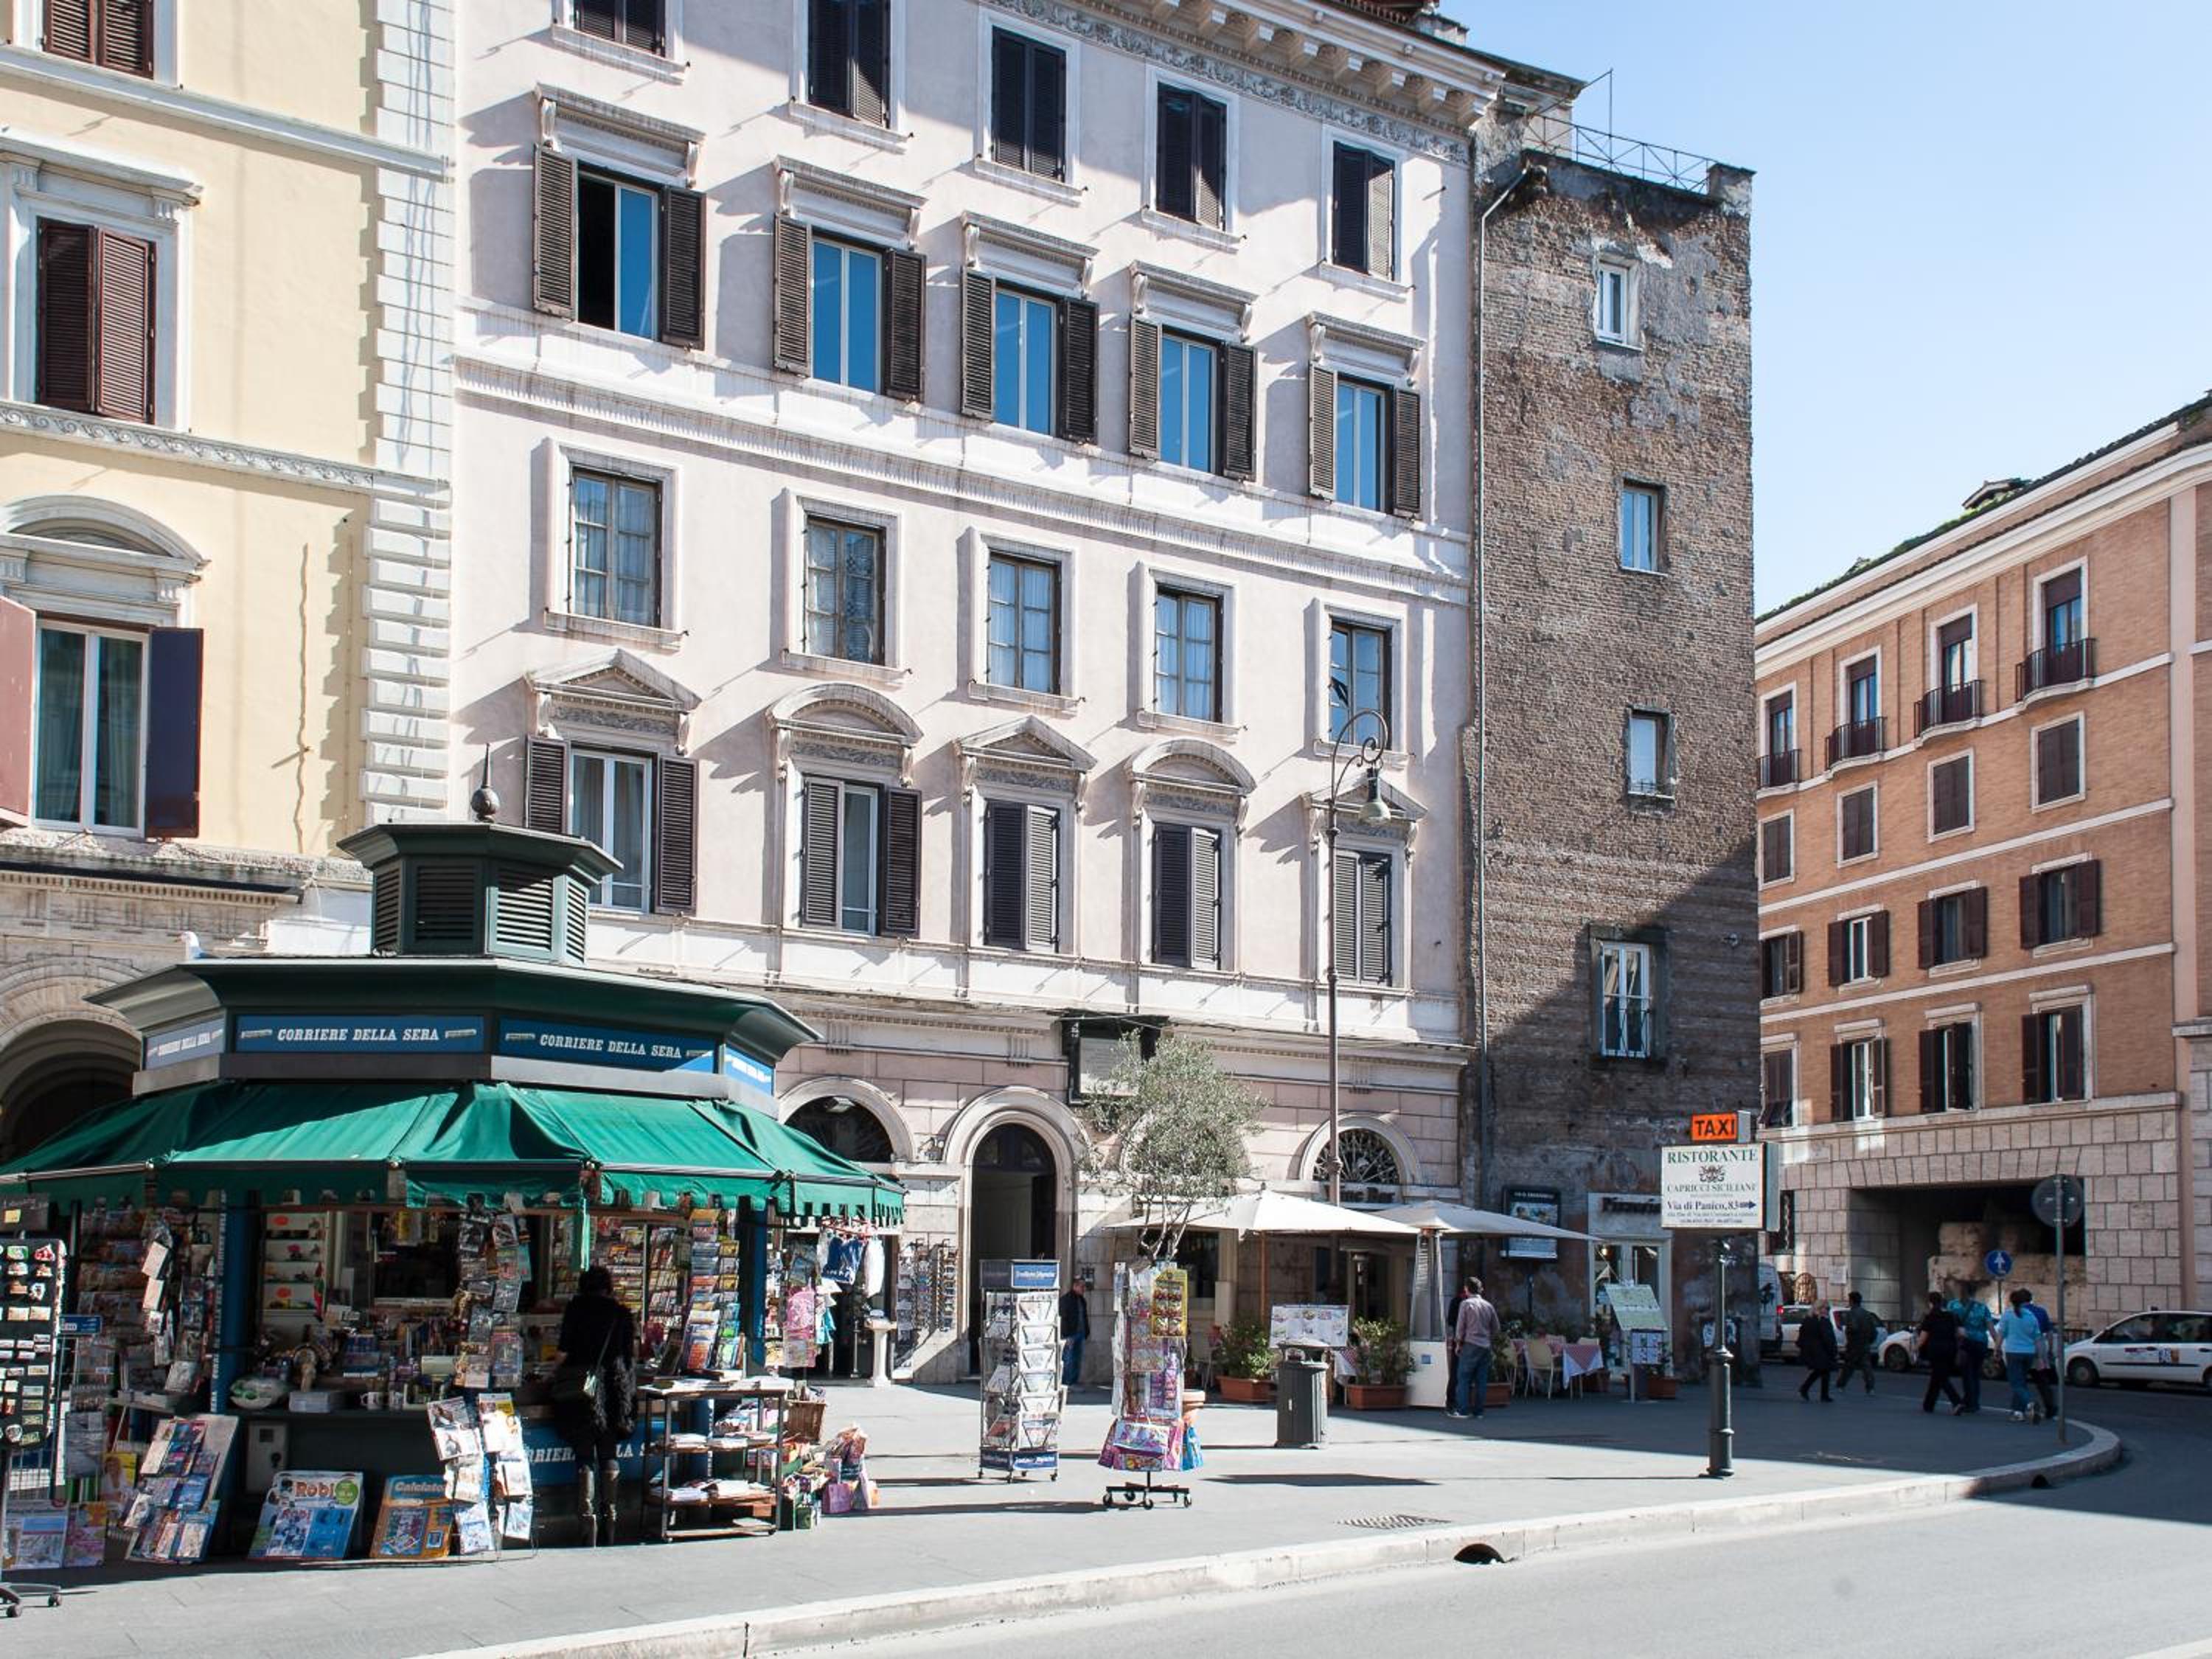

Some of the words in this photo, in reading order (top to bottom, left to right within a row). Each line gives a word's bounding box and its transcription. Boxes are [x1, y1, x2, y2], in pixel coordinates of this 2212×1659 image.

[277, 1028, 348, 1041] CORRIERE
[352, 1028, 397, 1041] DELLA
[402, 1028, 439, 1041] SERA
[540, 1034, 603, 1051] CORRIERE
[607, 1041, 647, 1056] DELLA
[651, 1045, 682, 1059] SERA
[1694, 1119, 1735, 1136] TAXI
[1667, 1148, 1758, 1164] RISTORANTE
[1667, 1183, 1710, 1193] CAPRICCI
[1667, 1200, 1682, 1210] Via
[1683, 1200, 1693, 1210] di
